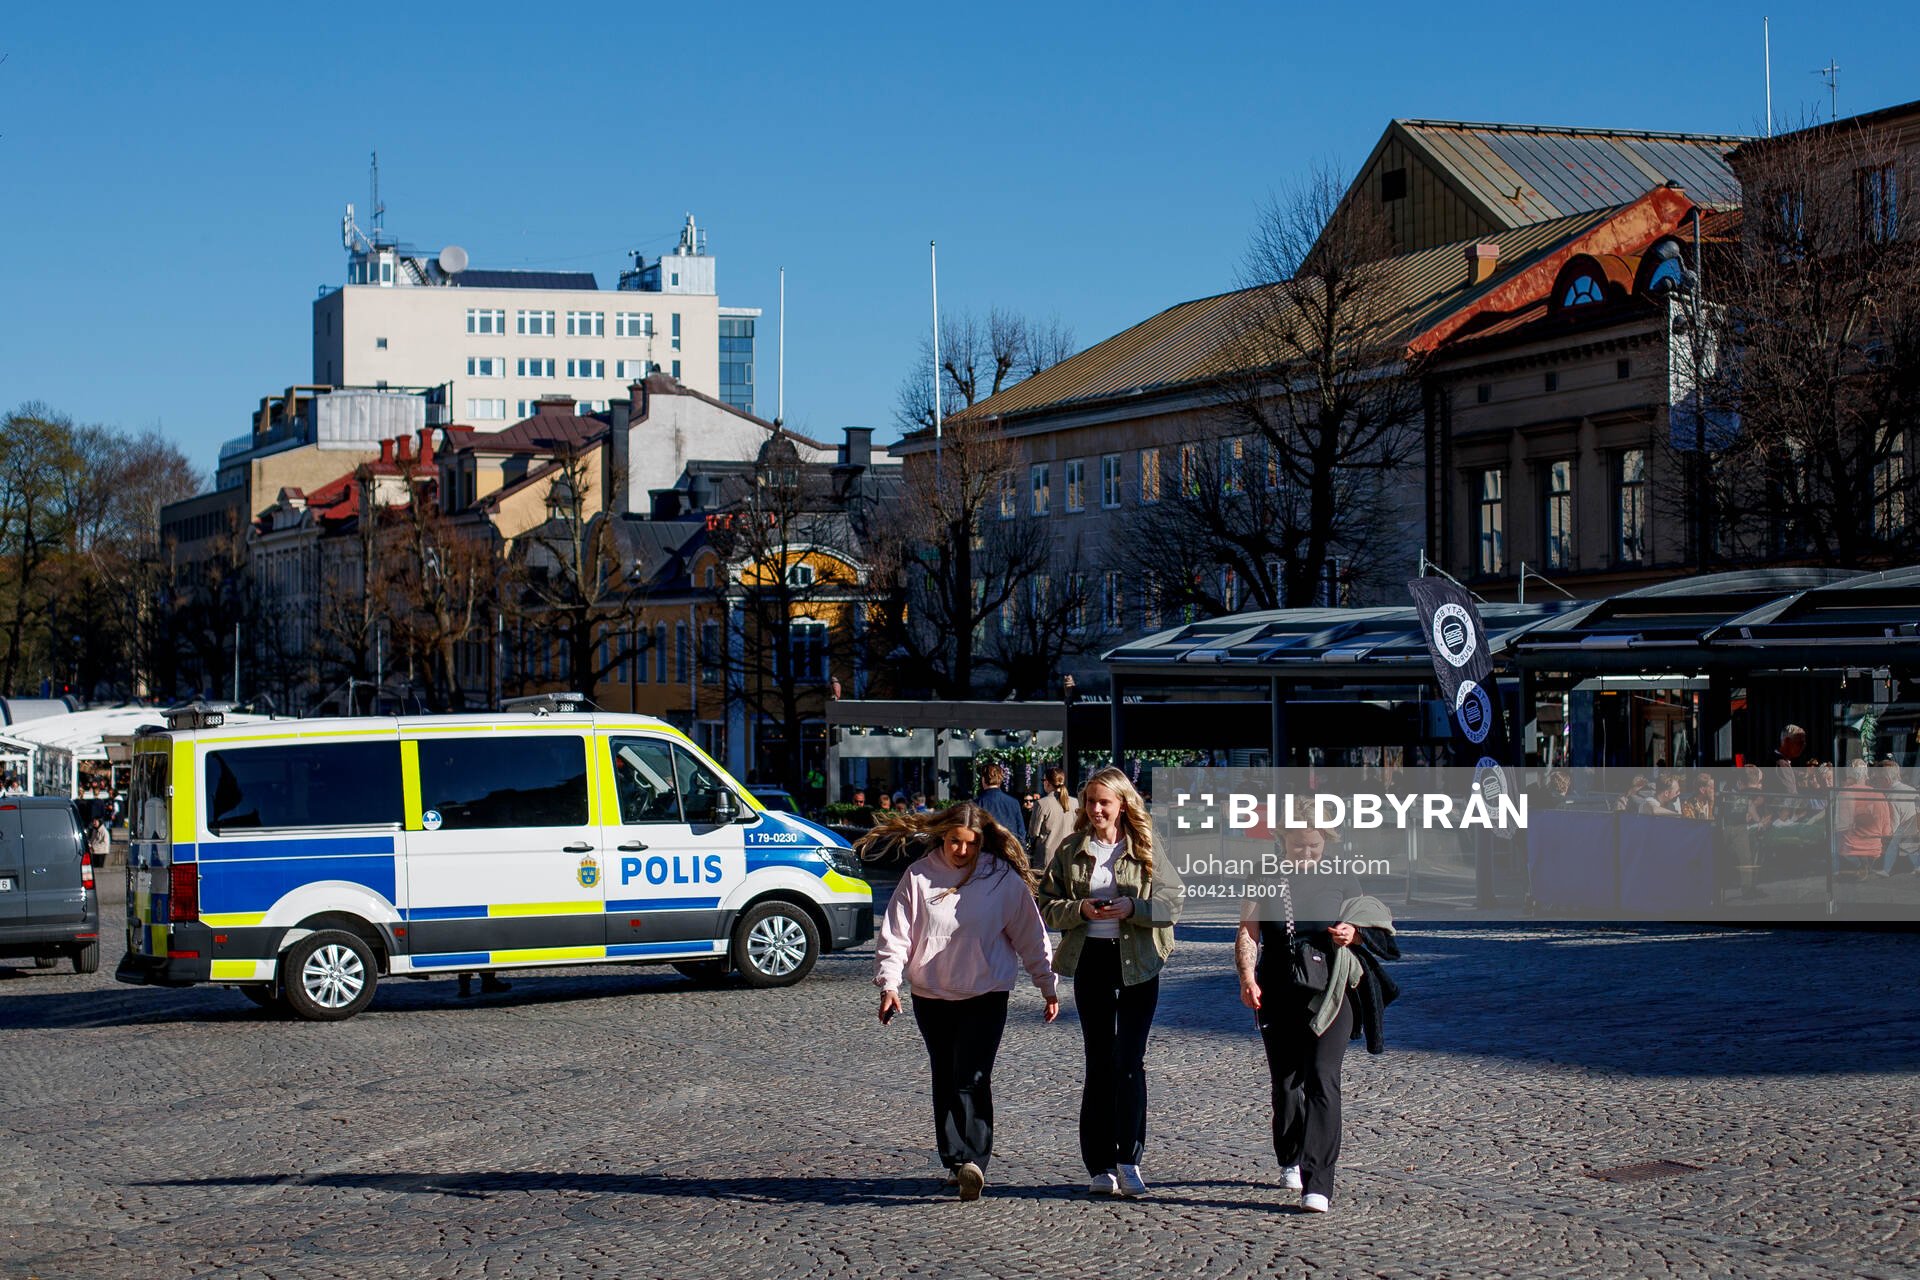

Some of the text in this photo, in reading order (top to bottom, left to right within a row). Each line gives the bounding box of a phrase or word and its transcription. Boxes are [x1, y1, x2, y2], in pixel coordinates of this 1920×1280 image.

[749, 833, 798, 843] 1 79-0230
[621, 854, 723, 886] POLIS
